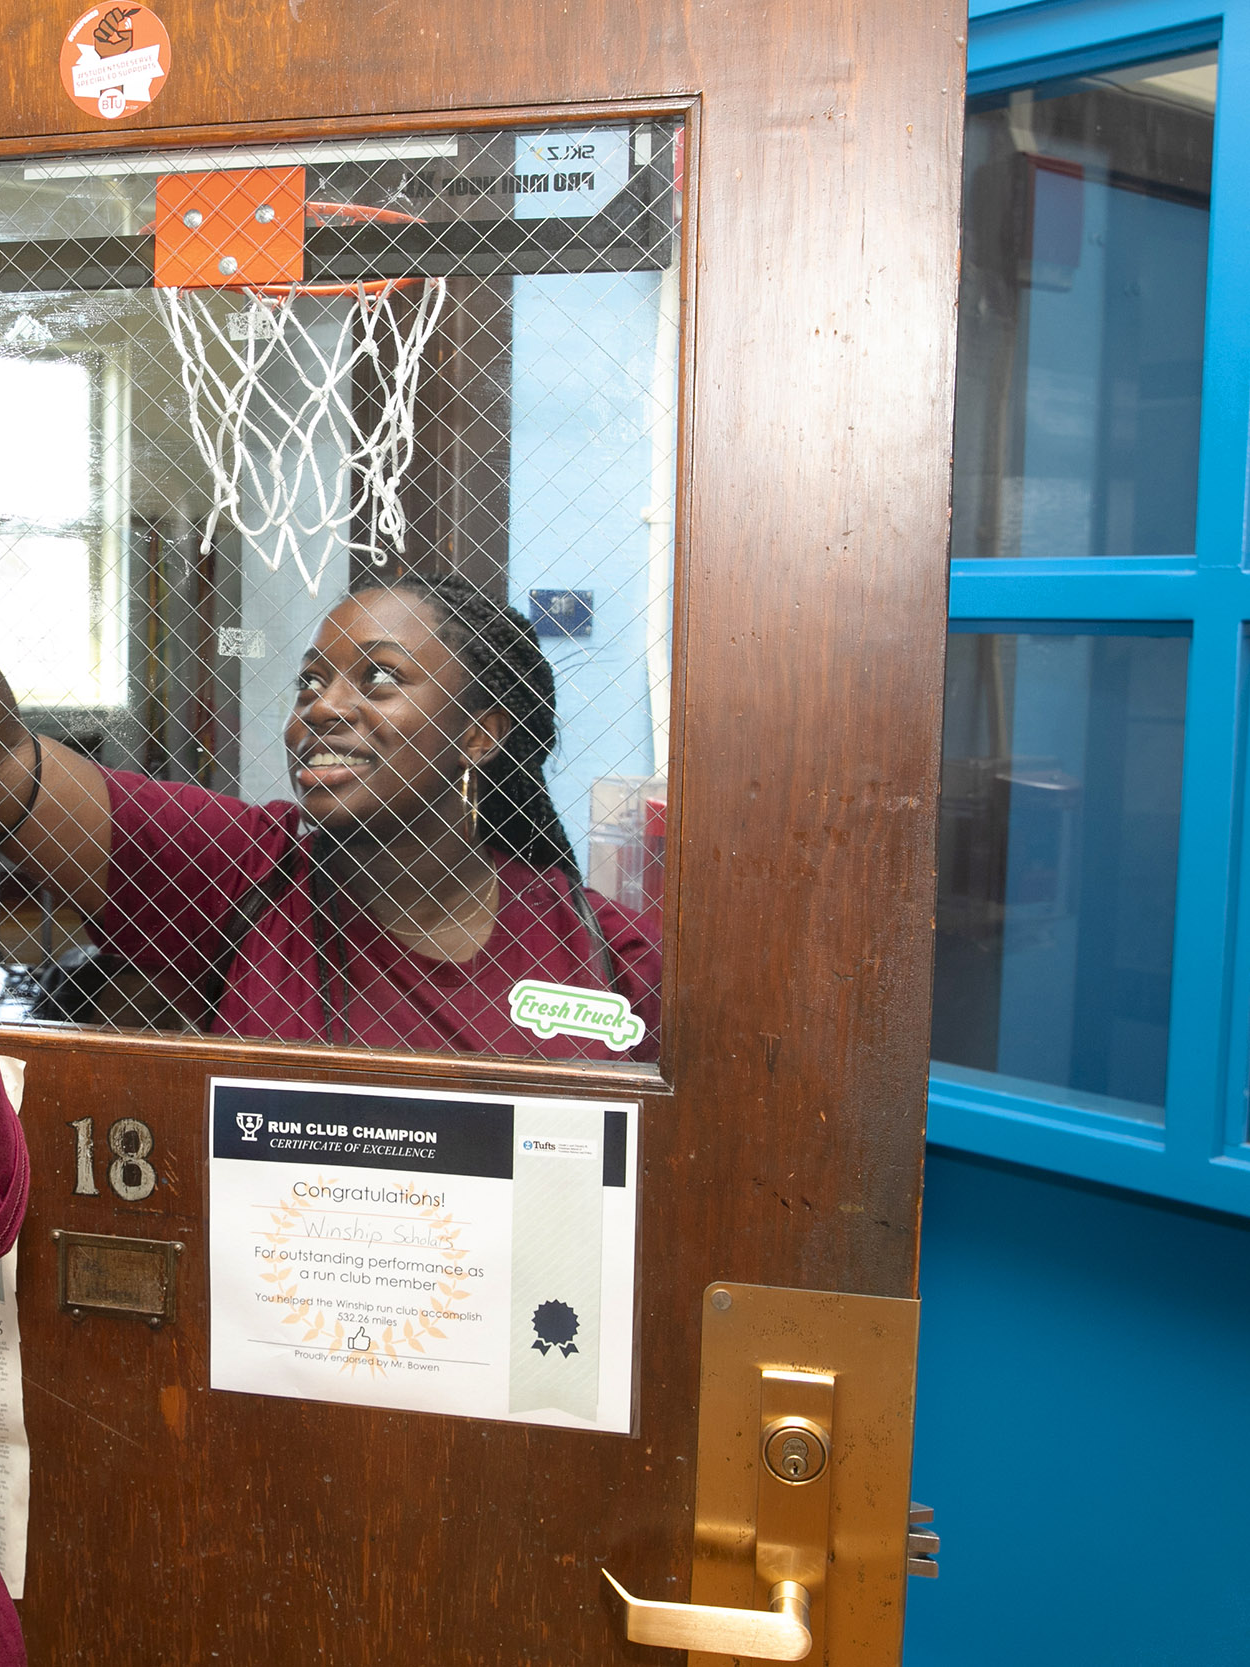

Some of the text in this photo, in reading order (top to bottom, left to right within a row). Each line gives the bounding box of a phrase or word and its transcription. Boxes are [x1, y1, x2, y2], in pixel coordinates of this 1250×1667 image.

[76, 76, 105, 88] SPECIAL
[118, 63, 156, 77] SUPPORTS
[78, 55, 152, 79] #STUDENTSDESERVE
[102, 95, 122, 110] BTU
[519, 994, 626, 1028] Fresh Truck
[268, 1120, 438, 1144] RUN CLUB CHAMPION
[269, 1138, 436, 1159] CERTIFICATE OF EXCELLENCE
[533, 1140, 556, 1151] Tufts
[66, 1116, 158, 1201] 18
[293, 1181, 445, 1208] Congratulations!
[302, 1214, 455, 1250] Winship Scholars
[254, 1246, 484, 1278] For outstanding performance as
[299, 1269, 437, 1292] a run club member
[255, 1292, 483, 1323] You helped the Winship run club accomplish
[337, 1312, 398, 1327] 532.26 miles
[294, 1350, 440, 1373] Proudly endorsed by Mr. Bowen
